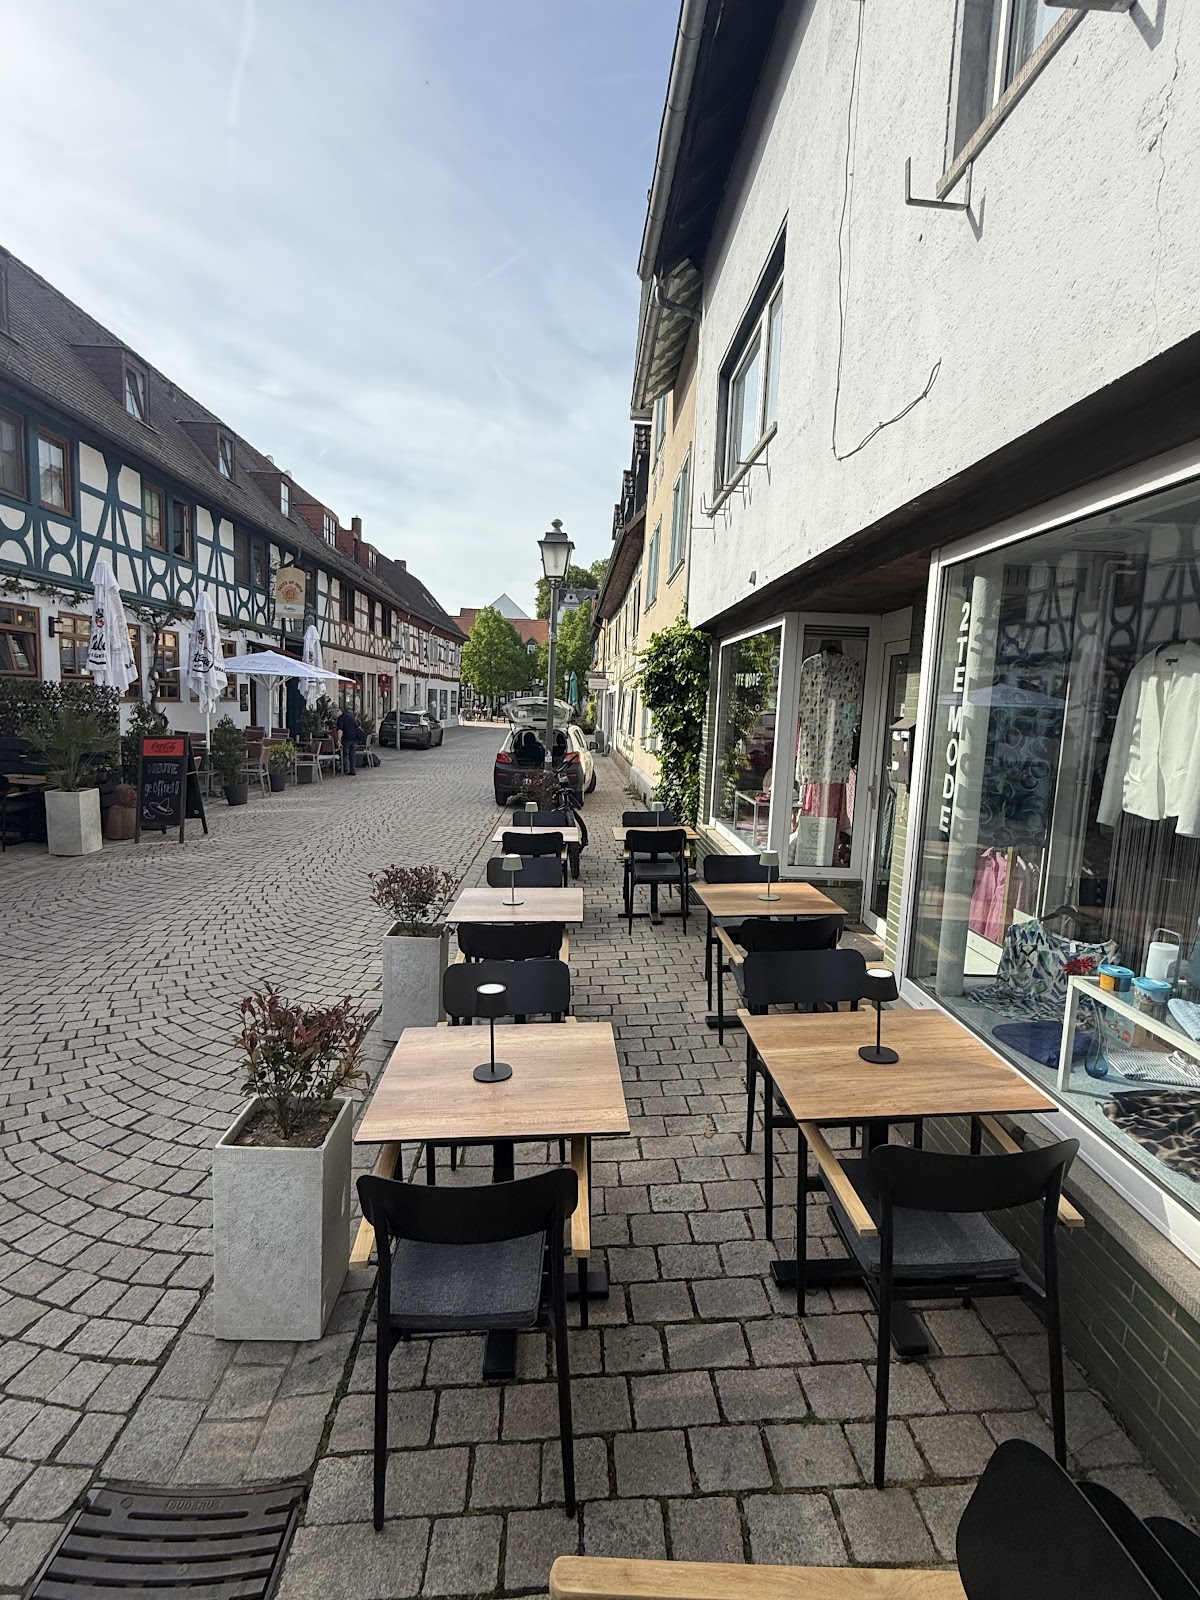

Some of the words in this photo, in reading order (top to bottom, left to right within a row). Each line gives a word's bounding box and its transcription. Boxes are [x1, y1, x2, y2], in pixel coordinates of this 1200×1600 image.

[953, 601, 971, 693] 2TE
[147, 762, 180, 775] HEUTE
[939, 706, 963, 833] MODE
